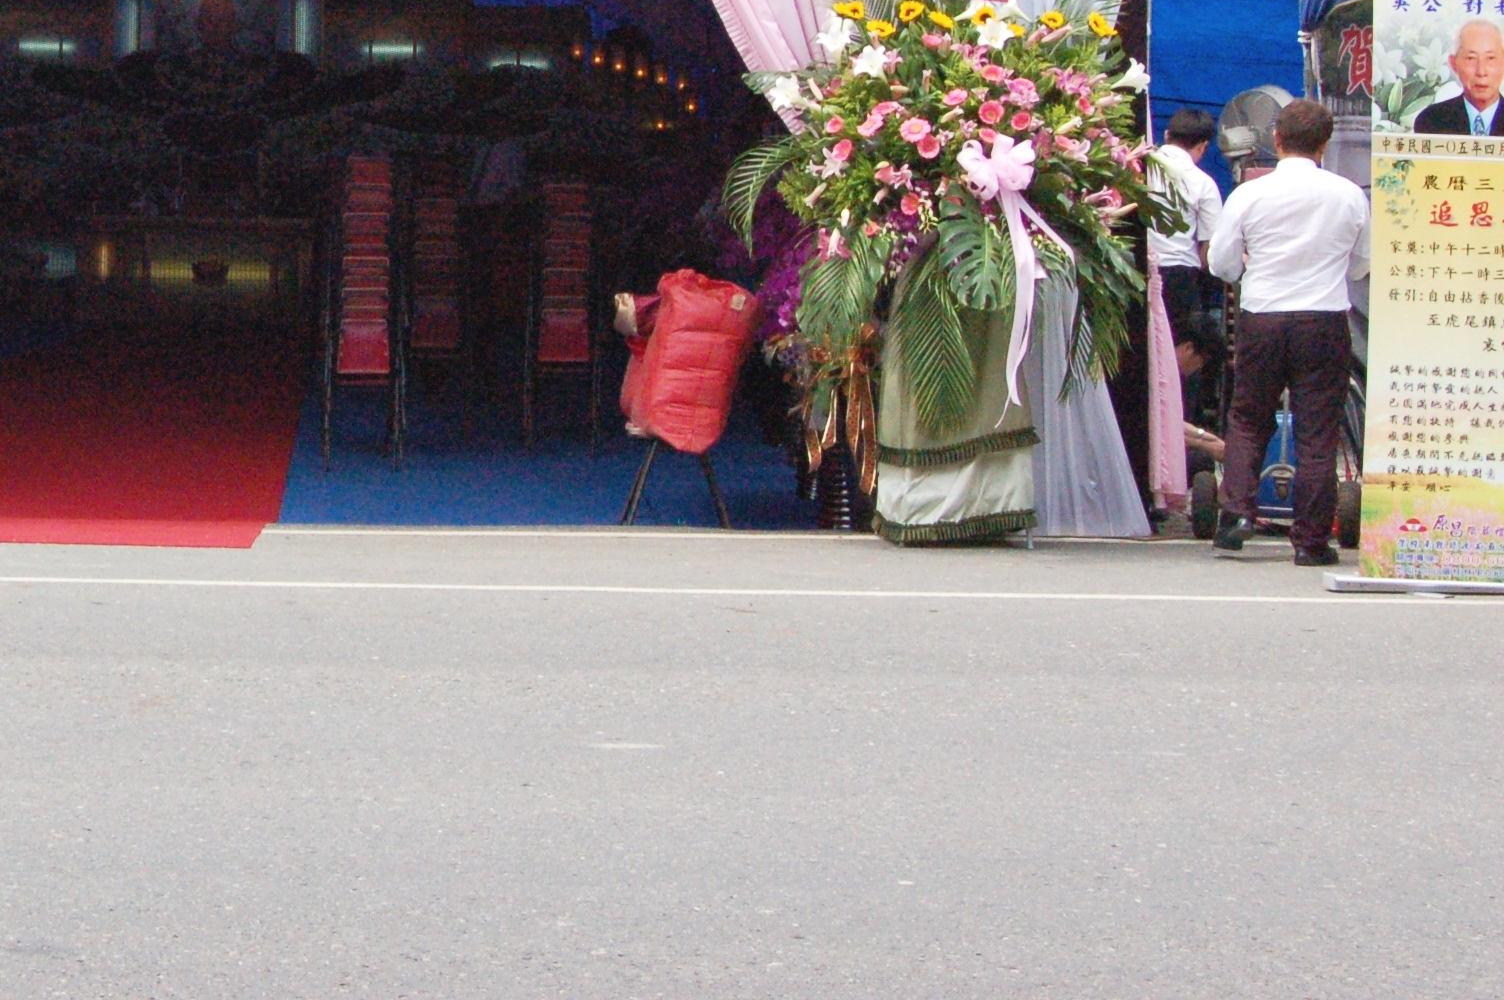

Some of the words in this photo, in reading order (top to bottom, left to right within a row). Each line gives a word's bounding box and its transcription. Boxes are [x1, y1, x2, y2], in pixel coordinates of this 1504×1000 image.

[1429, 200, 1504, 227] 追思
[1427, 313, 1504, 329] 至虎尾鎮
